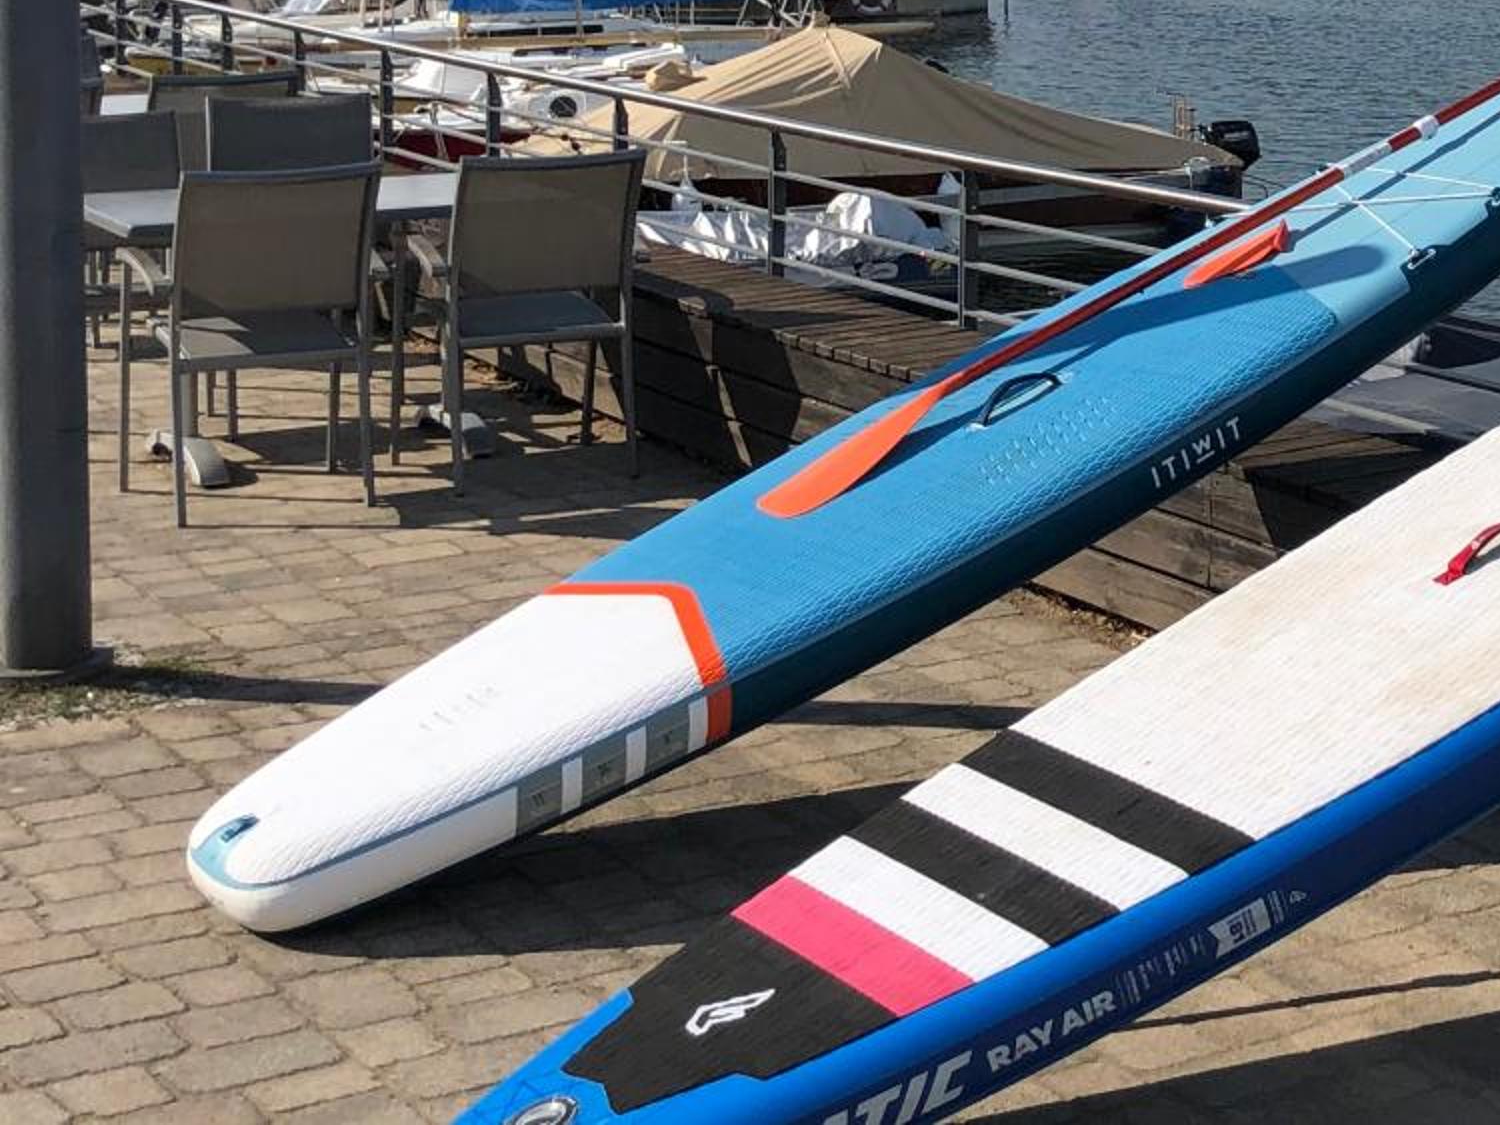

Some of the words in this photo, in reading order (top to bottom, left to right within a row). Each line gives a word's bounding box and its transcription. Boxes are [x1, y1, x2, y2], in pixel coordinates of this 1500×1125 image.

[1151, 416, 1239, 488] ITIWIT
[987, 1019, 1053, 1073] RAY
[1062, 990, 1117, 1036] AIR
